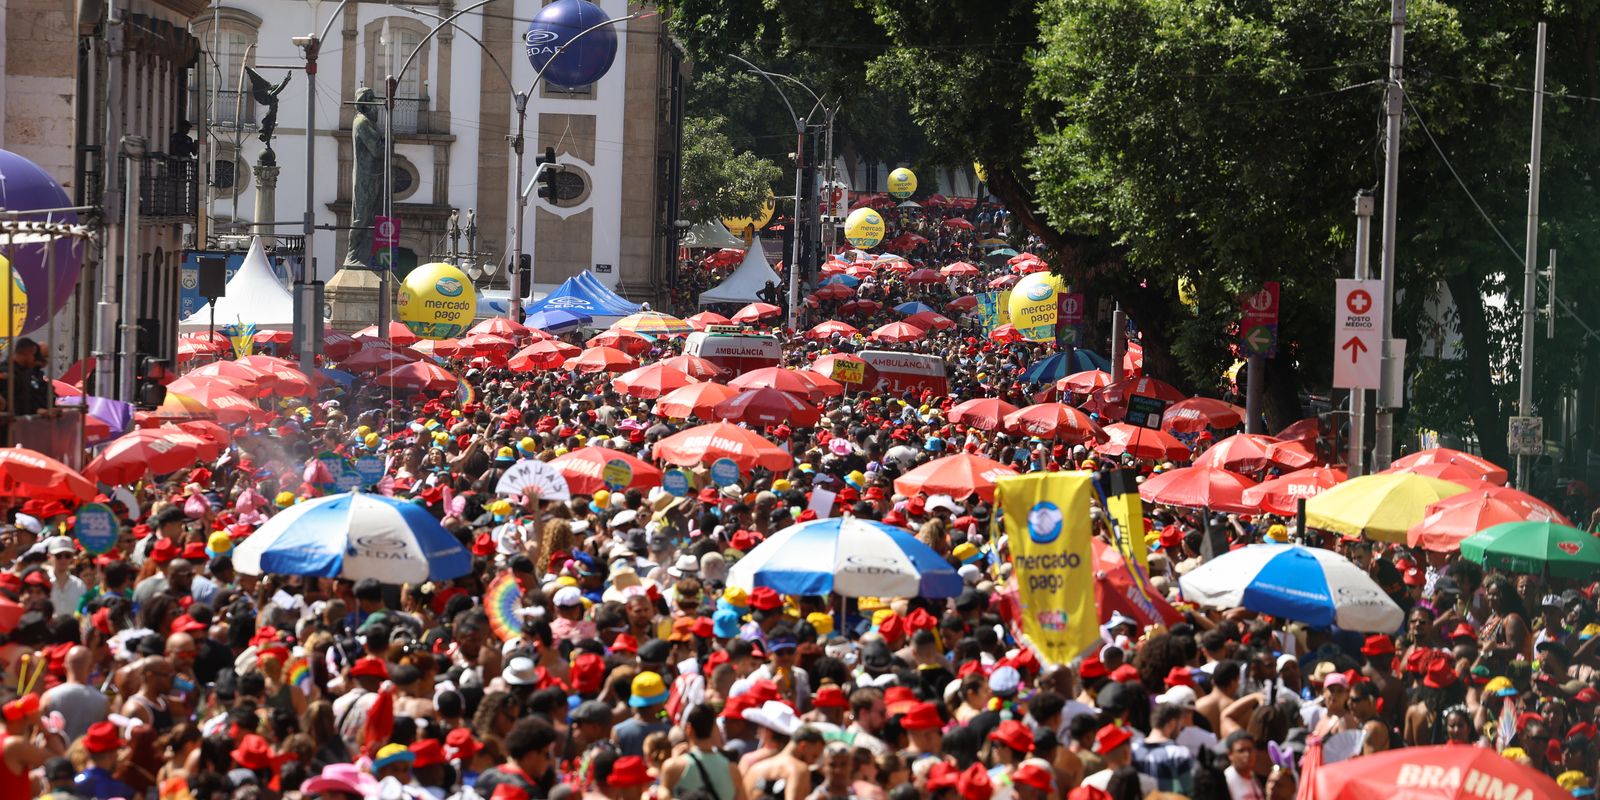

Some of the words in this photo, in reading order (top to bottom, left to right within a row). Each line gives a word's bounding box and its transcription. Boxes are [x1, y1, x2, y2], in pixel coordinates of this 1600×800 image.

[425, 300, 470, 310] mercado
[1021, 302, 1057, 316] mercad
[434, 310, 461, 321] pago
[1031, 313, 1056, 323] pago
[715, 346, 764, 356] AMBULÂNCIA
[872, 359, 931, 370] AMBULÂNCIA
[1016, 551, 1081, 570] mercado
[1029, 573, 1063, 594] pago
[1397, 763, 1535, 800] BRAHMA
